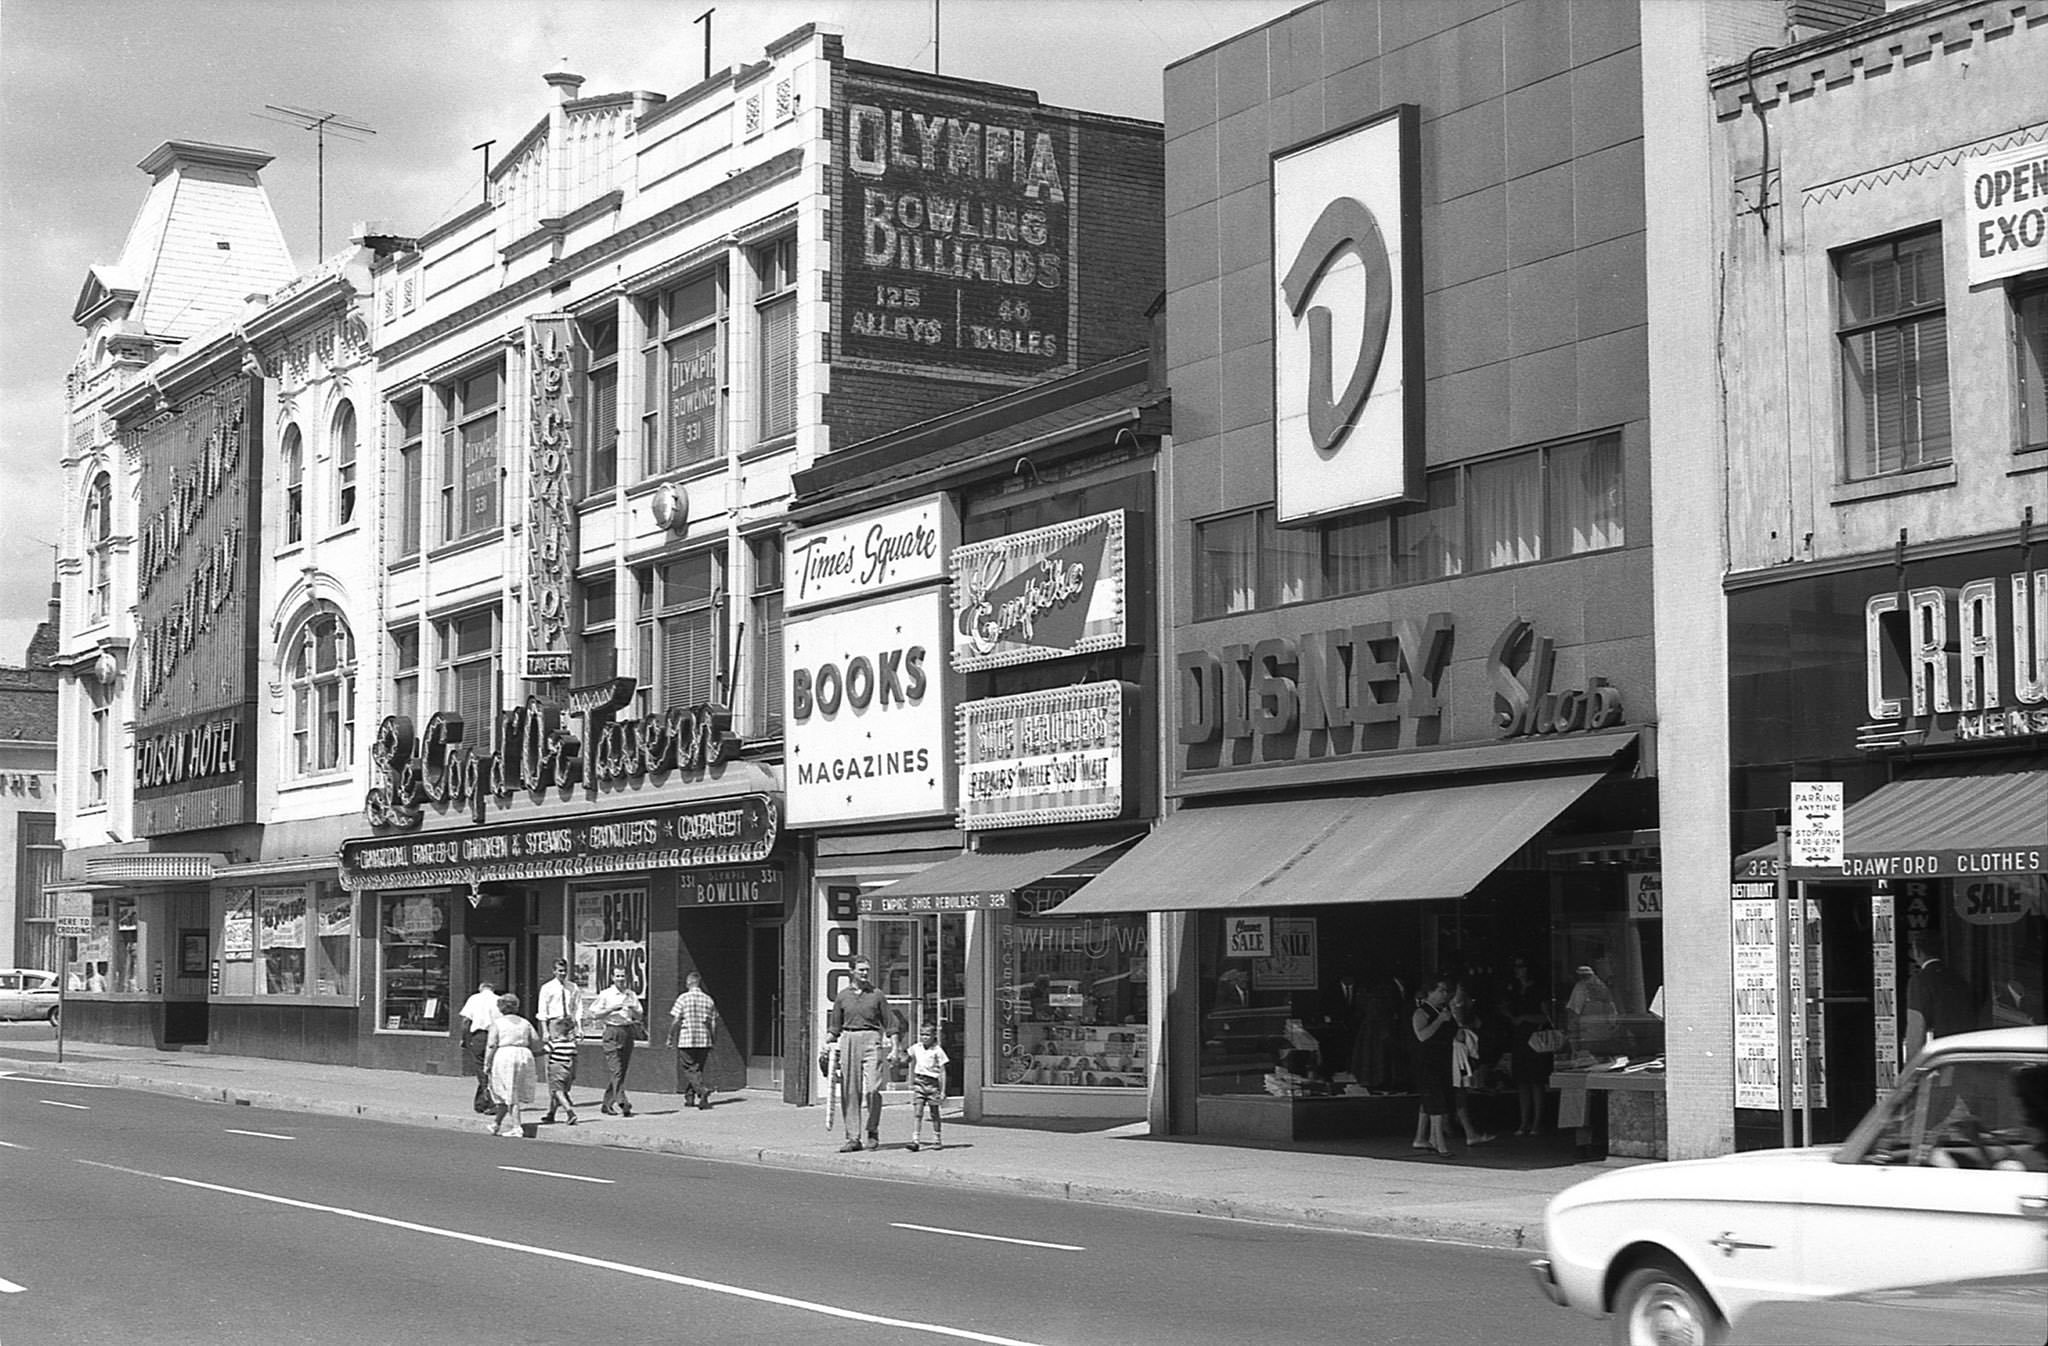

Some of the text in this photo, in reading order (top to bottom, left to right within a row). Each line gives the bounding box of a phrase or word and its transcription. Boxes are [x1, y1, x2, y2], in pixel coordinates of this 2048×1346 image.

[849, 103, 1064, 202] OLYMPIA
[1974, 159, 2048, 210] OPEN
[863, 187, 1048, 256] BOWLING
[863, 205, 1062, 288] BILLIARDS
[876, 285, 921, 307] 125
[851, 311, 942, 344] ALLEYS
[969, 324, 1057, 357] TABLES
[1280, 196, 1392, 452] D
[672, 350, 716, 392] OLYMPIA
[674, 386, 715, 417] BOWLING
[860, 523, 937, 585] Square
[966, 559, 1084, 655] Empire
[528, 656, 570, 673] TAVERN
[1178, 612, 1624, 748] DISNEY Shop
[792, 645, 927, 724] BOOKS
[137, 719, 236, 789] EDISON HOTEL
[798, 747, 929, 785] MAGAZINES
[1795, 794, 1841, 802] PARKING
[525, 829, 571, 855] STEAKS
[589, 819, 657, 849] BANQUETS
[677, 810, 744, 841] CABARET
[680, 874, 696, 888] 331
[761, 869, 777, 883] 331
[1842, 855, 1938, 876] CRAWFORD
[1957, 851, 2040, 873] CLOTHES
[697, 881, 759, 903] BOWLING
[912, 896, 931, 909] SHOE
[935, 894, 980, 909] REBUILDERS
[1019, 887, 1073, 916] SHO
[1967, 883, 2022, 916] SALE
[57, 926, 91, 935] CROSSING
[58, 918, 90, 926] HERE TO
[602, 892, 645, 943] BEAU
[1018, 926, 1082, 953] WHILE
[1083, 918, 1111, 959] U
[1231, 933, 1265, 952] SALE
